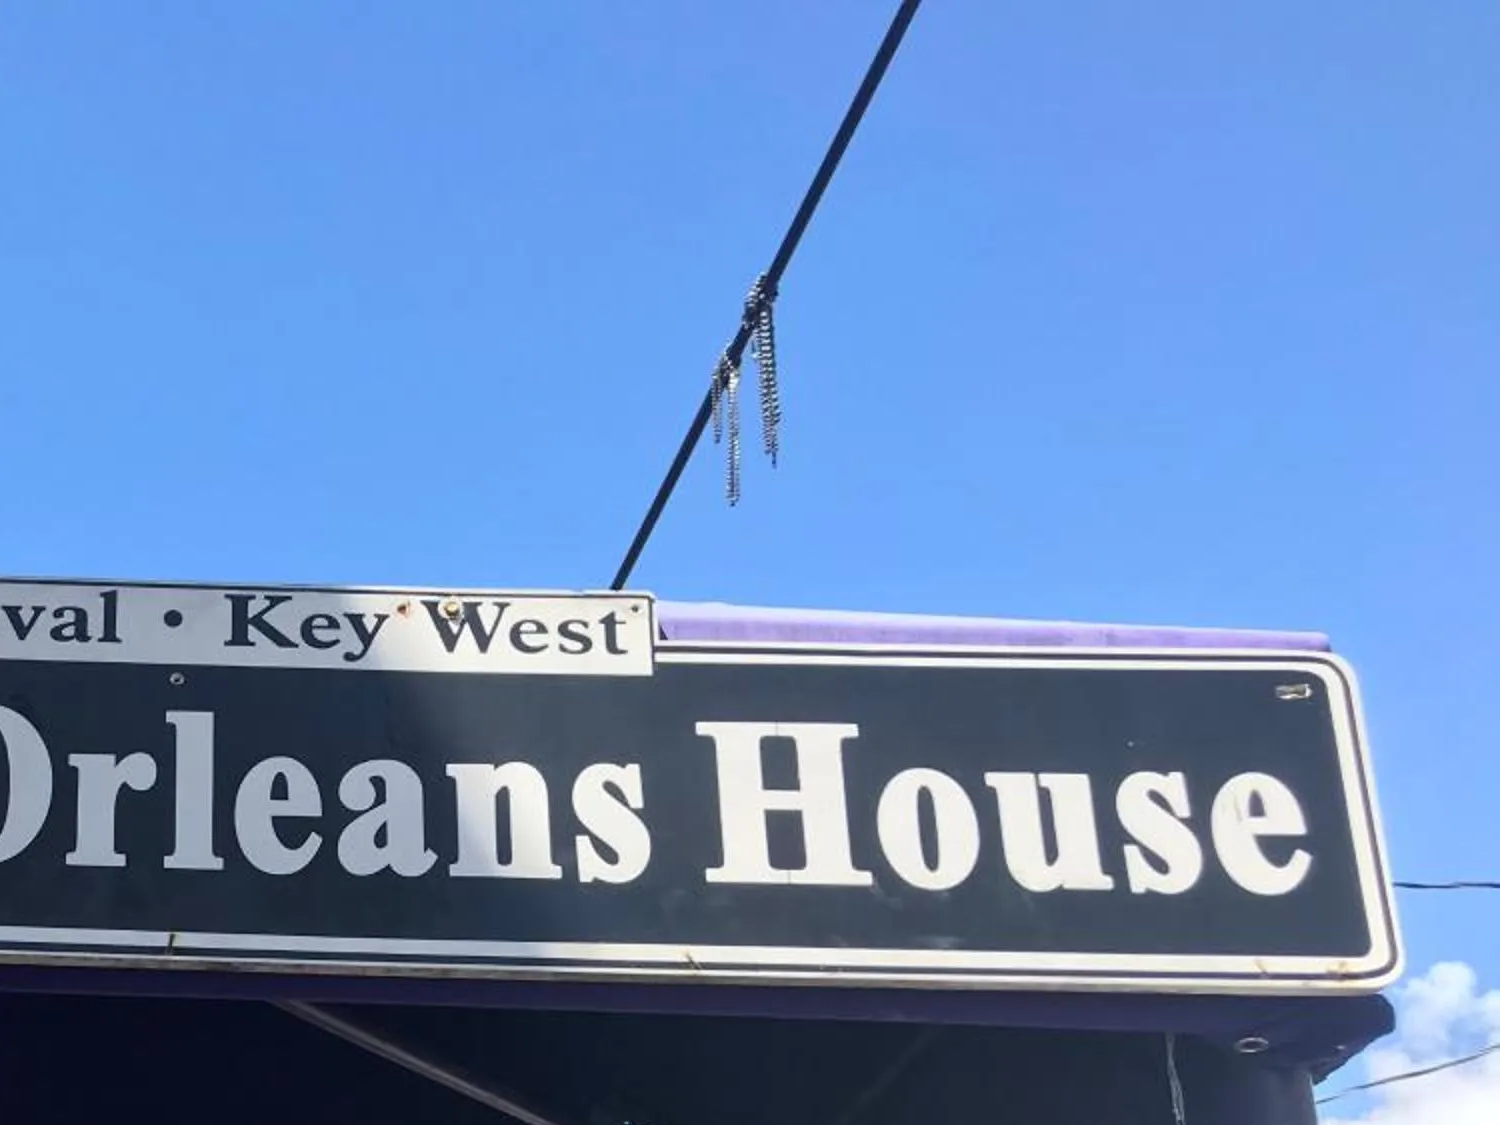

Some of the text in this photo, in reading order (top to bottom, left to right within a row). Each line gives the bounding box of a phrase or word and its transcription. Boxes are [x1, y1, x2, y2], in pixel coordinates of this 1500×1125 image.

[223, 593, 390, 662] Key
[420, 600, 627, 655] West
[694, 720, 1314, 897] House
